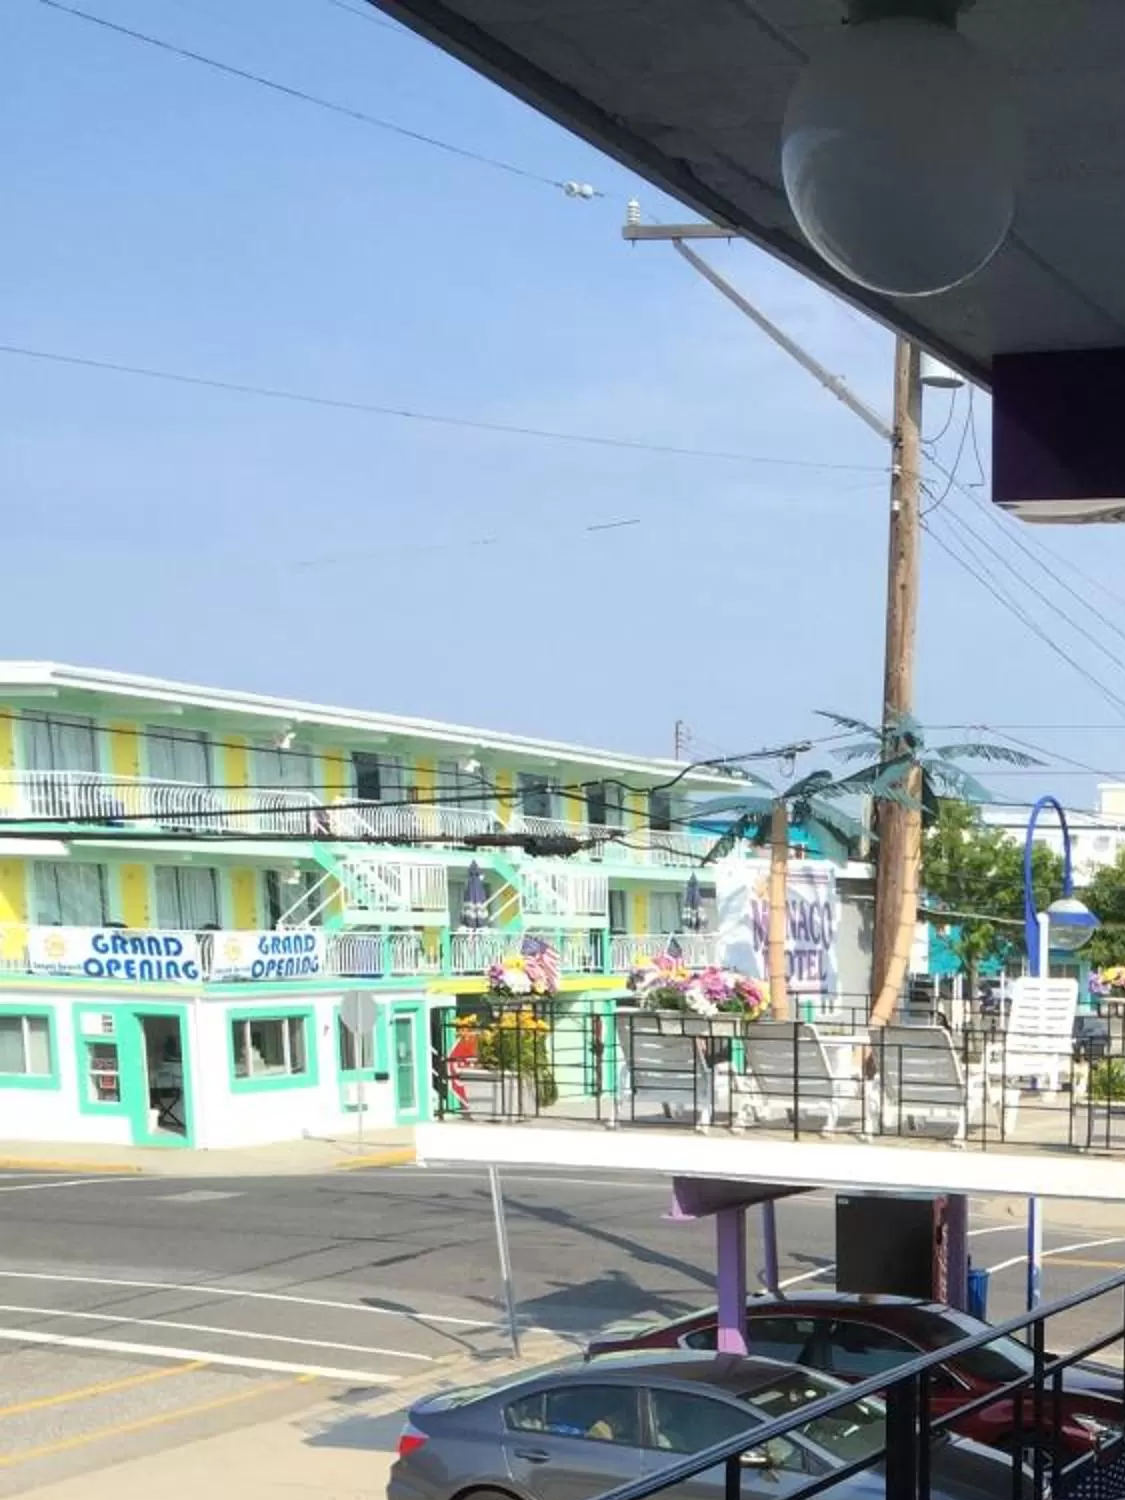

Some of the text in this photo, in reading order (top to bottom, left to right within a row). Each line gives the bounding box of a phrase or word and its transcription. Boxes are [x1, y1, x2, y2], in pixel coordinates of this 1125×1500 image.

[751, 899, 833, 951] MNACO
[91, 933, 183, 957] GRAND
[257, 933, 316, 956] GRAND
[83, 957, 199, 981] OPENING
[251, 955, 319, 979] OPENING
[763, 949, 827, 983] OTEL
